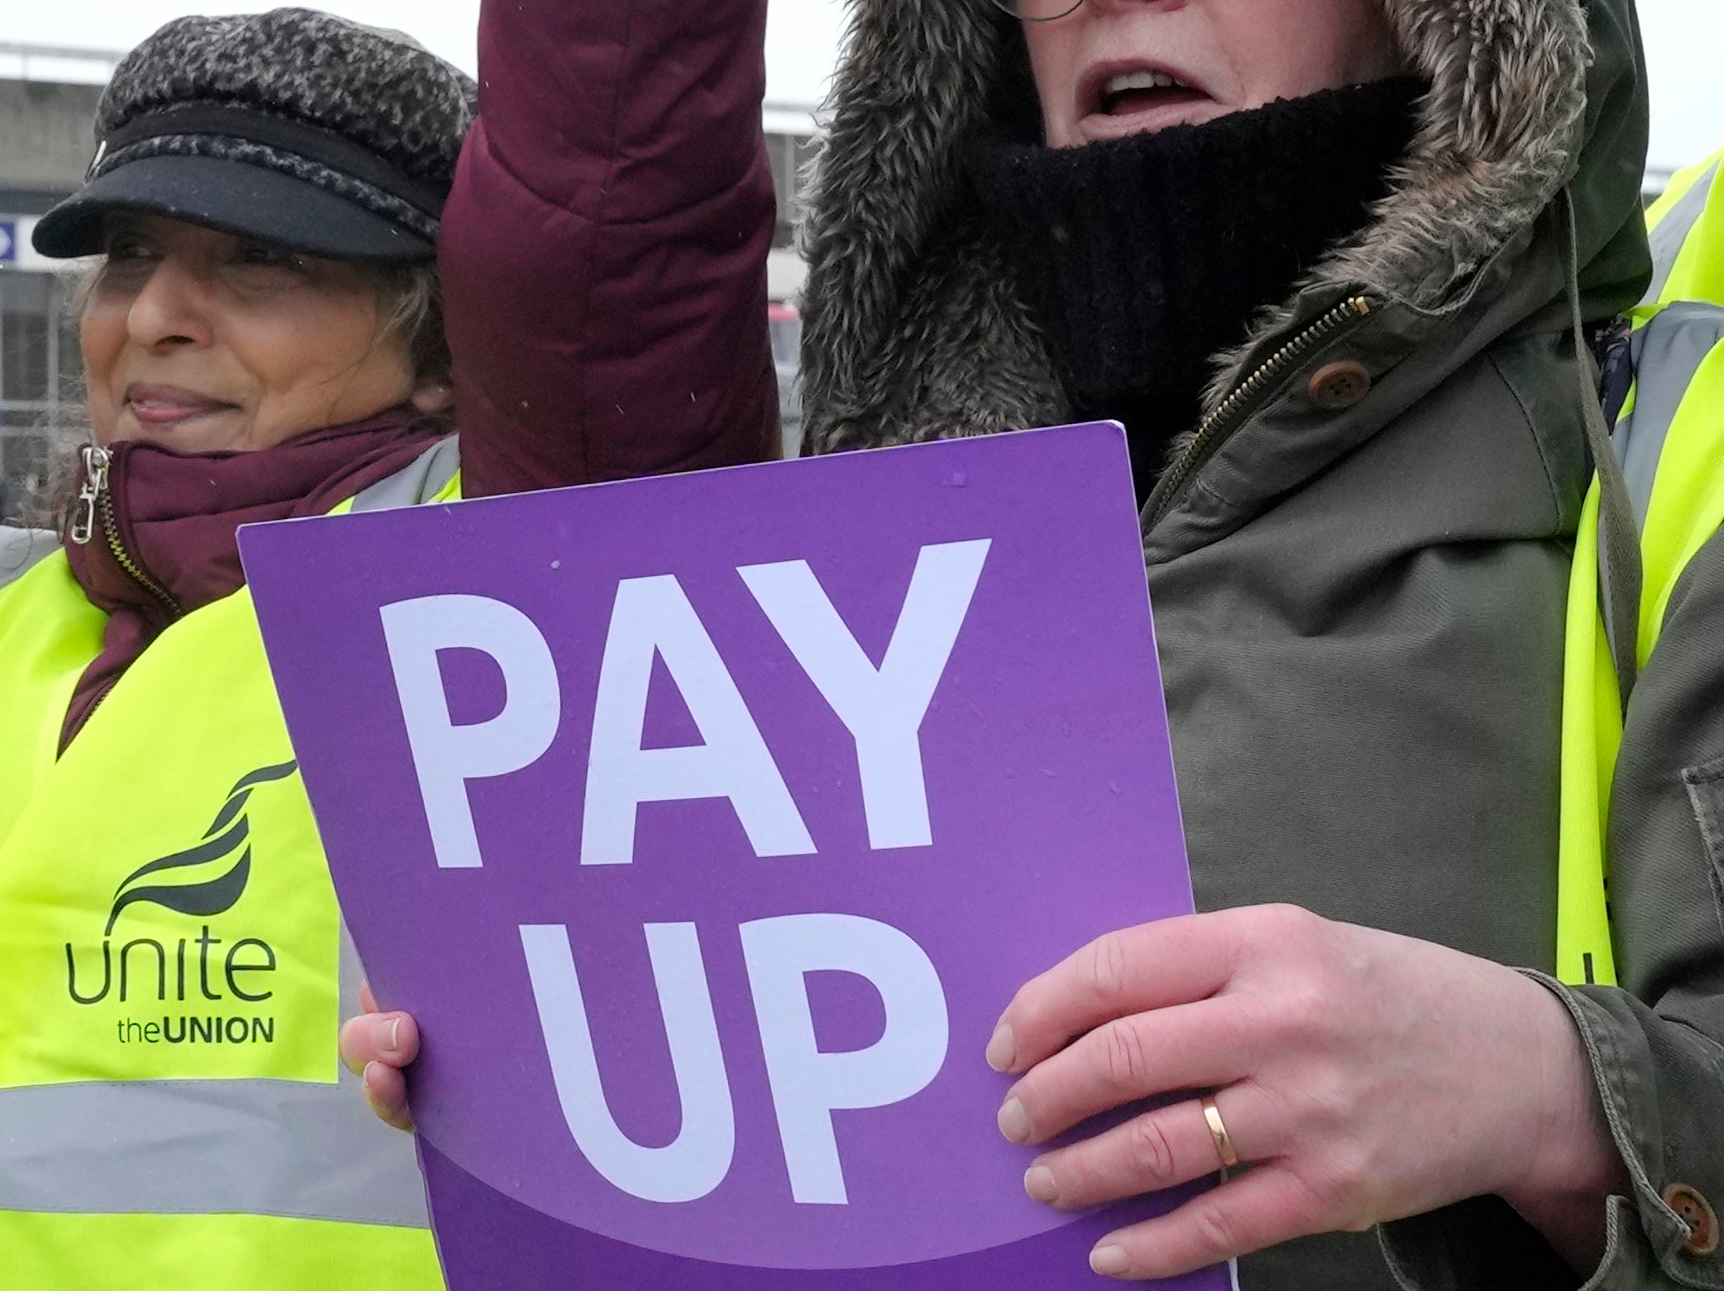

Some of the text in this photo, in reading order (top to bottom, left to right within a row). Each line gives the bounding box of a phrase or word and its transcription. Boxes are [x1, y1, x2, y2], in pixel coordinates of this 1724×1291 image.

[379, 538, 992, 868] PAY
[118, 1017, 274, 1044] theUNION
[519, 912, 949, 1204] UP
